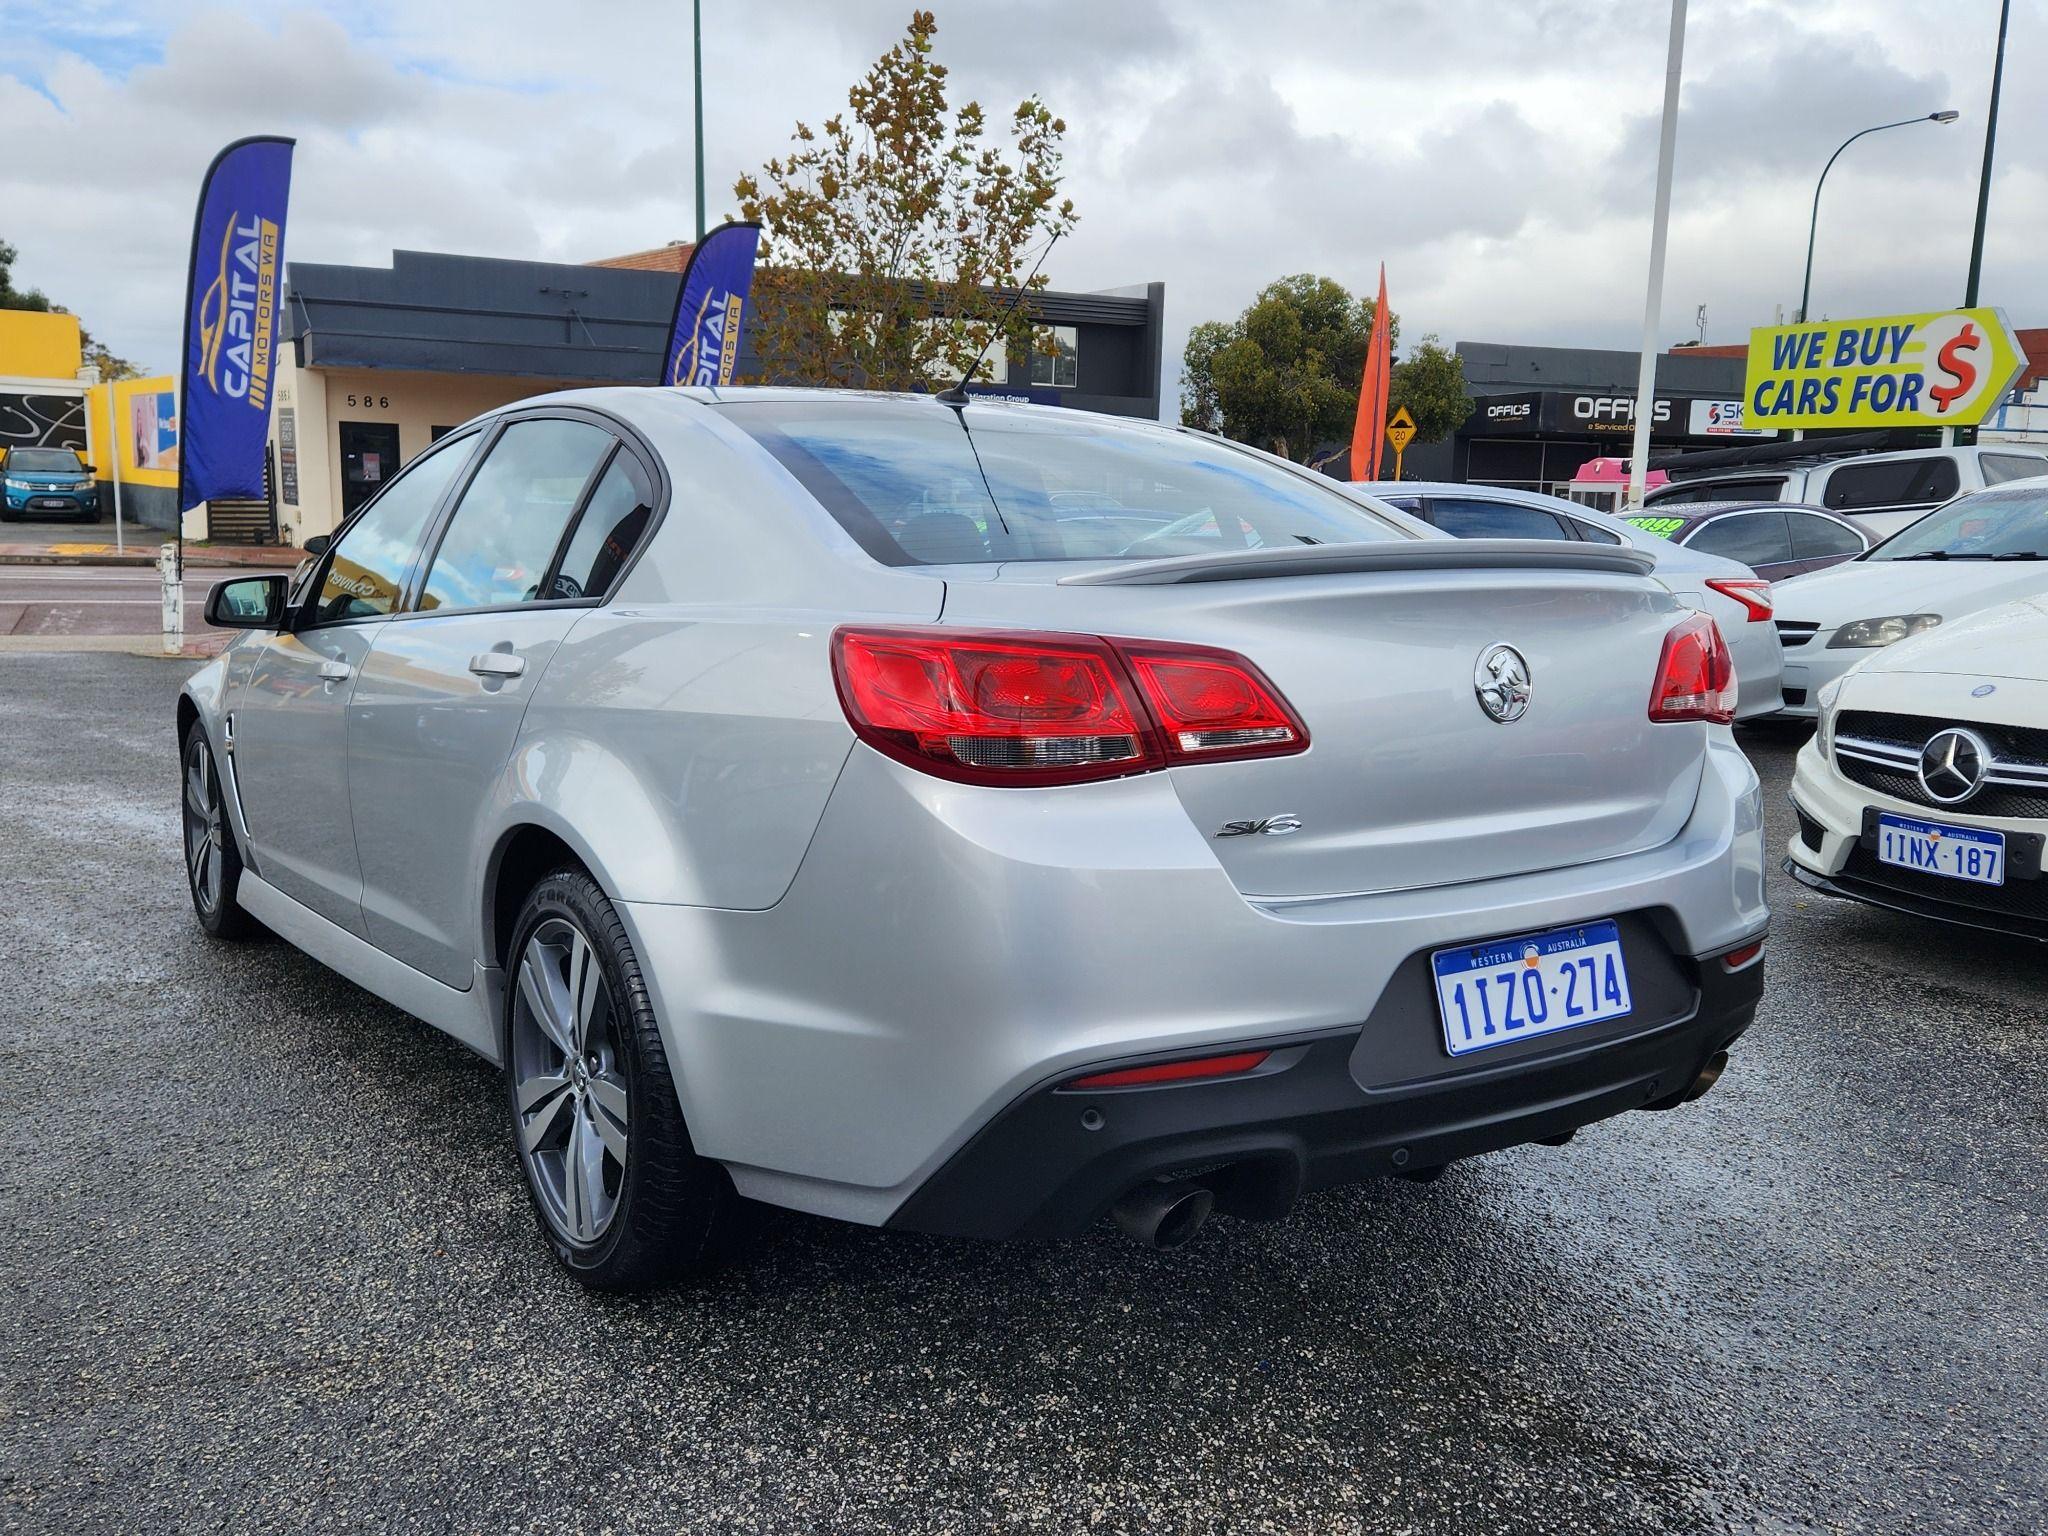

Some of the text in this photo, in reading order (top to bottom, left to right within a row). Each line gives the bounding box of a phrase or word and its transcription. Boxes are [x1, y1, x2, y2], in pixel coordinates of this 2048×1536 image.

[223, 214, 261, 398] CAPITAL
[255, 232, 275, 366] MOTORS WA
[727, 306, 740, 335] WA
[1772, 324, 1916, 371] WE BUY
[1753, 323, 1981, 417] CARS FOR $
[347, 394, 390, 409] 586
[1006, 394, 1030, 404] Group
[1574, 396, 1671, 422] OFFIS
[1394, 430, 1406, 441] 20
[1594, 422, 1628, 432] Serviced
[1213, 813, 1303, 839] SV6
[1899, 823, 1979, 841] WESTERN AUSTRALIA
[1470, 937, 1588, 968] WESTERN AUSTRALIA
